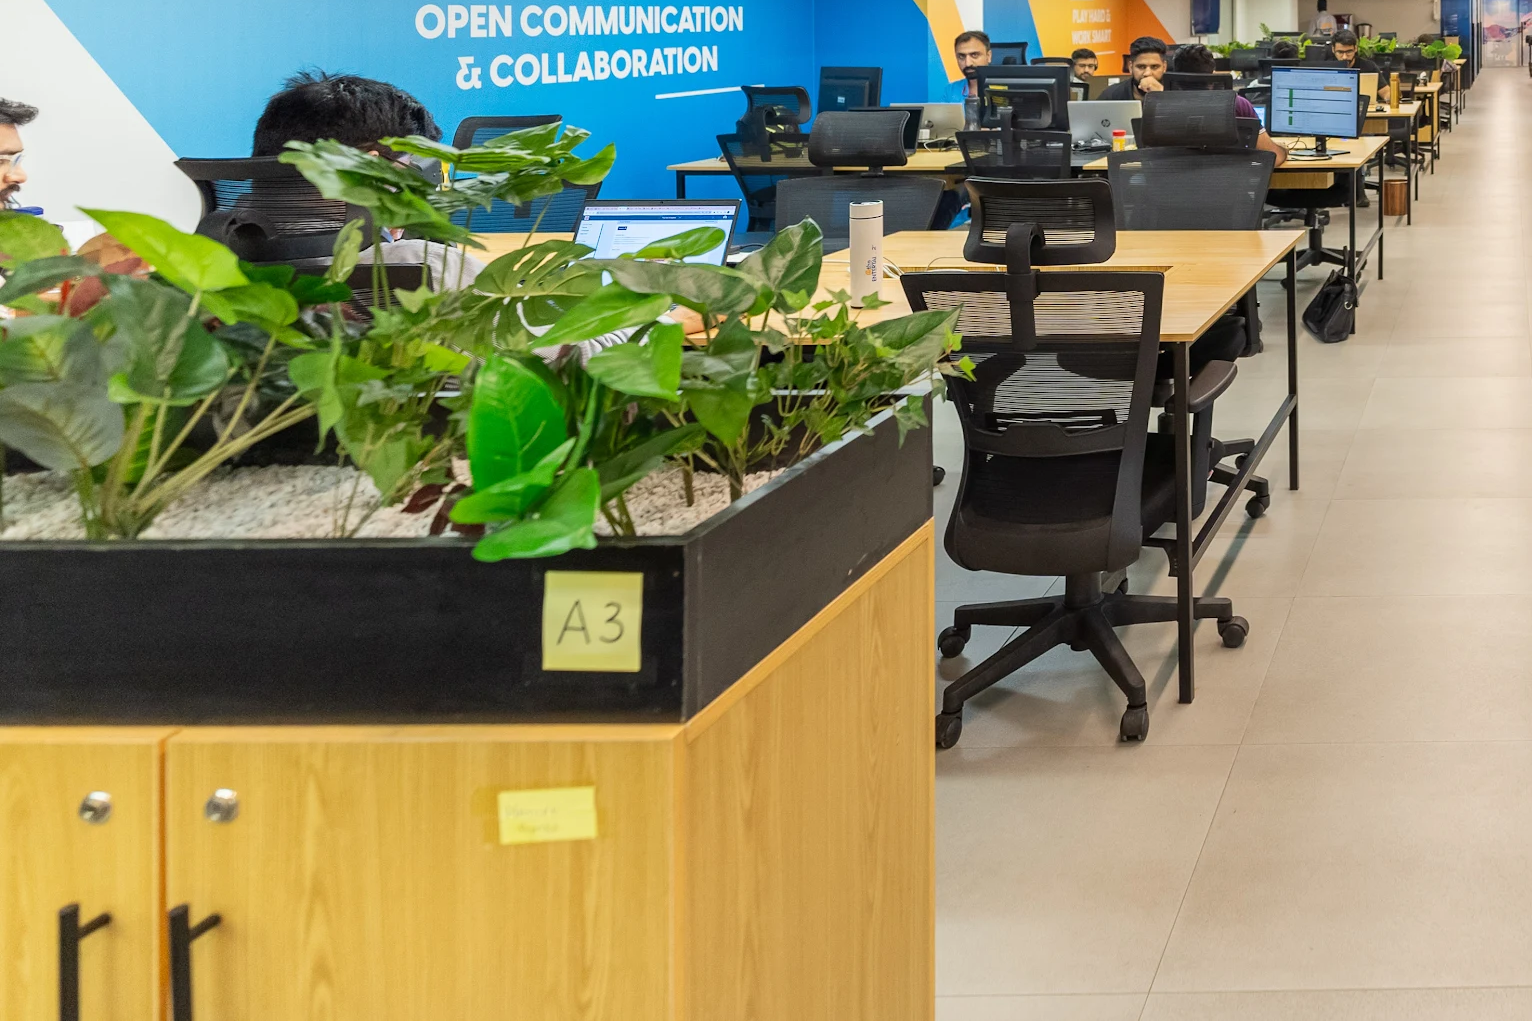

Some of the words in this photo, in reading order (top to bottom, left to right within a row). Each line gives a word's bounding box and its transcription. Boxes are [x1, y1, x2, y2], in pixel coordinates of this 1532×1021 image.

[415, 4, 513, 40] OPEN
[520, 5, 744, 36] COMMUNICATION
[1072, 9, 1088, 24] PLAY
[1089, 9, 1105, 23] HARD
[1105, 8, 1111, 23] &
[1071, 30, 1091, 45] WORK
[1092, 29, 1112, 43] SMART
[455, 56, 482, 90] &
[490, 45, 719, 85] COLLABORATION
[555, 598, 625, 646] A3
